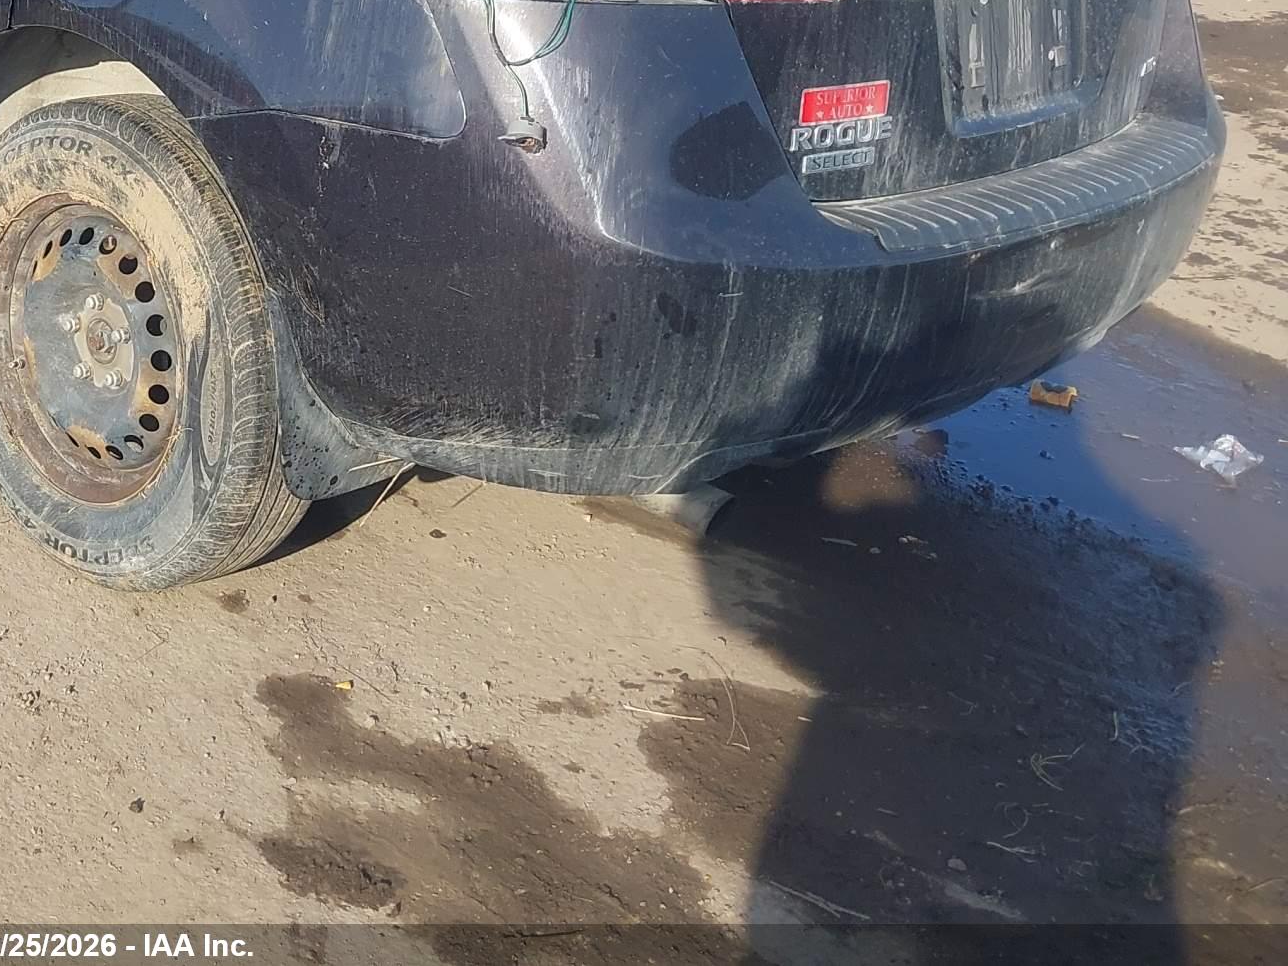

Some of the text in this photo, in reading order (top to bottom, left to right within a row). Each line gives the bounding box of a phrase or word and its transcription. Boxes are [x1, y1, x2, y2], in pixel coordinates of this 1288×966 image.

[828, 103, 863, 120] AUTO
[790, 116, 893, 152] ROGUE
[812, 151, 870, 170] SELECT
